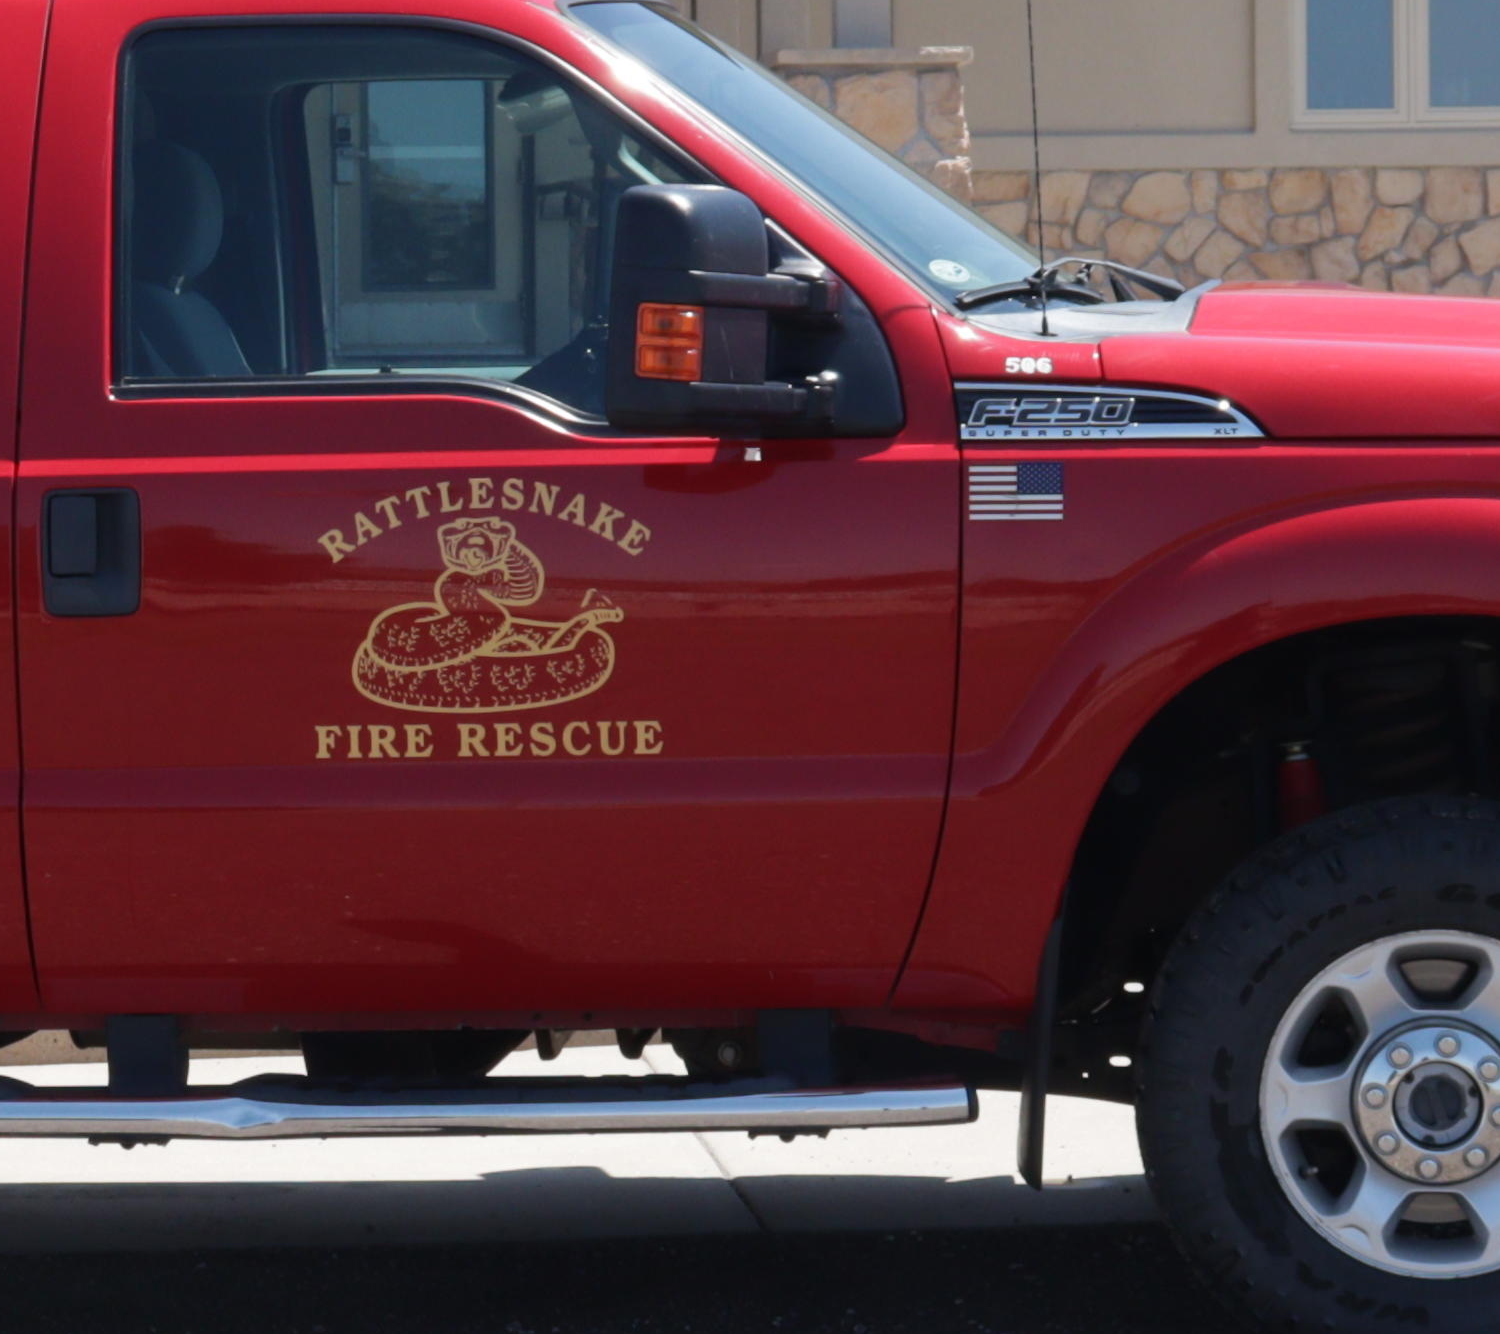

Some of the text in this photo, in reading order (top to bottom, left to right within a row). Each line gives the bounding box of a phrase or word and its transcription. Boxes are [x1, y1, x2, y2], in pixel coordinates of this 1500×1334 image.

[967, 397, 1136, 427] F-250
[968, 428, 1125, 437] SUPER DUTY
[1214, 427, 1239, 435] XLT
[317, 477, 652, 564] RATTLESNAKE
[315, 720, 664, 759] FIRE RESCUE
